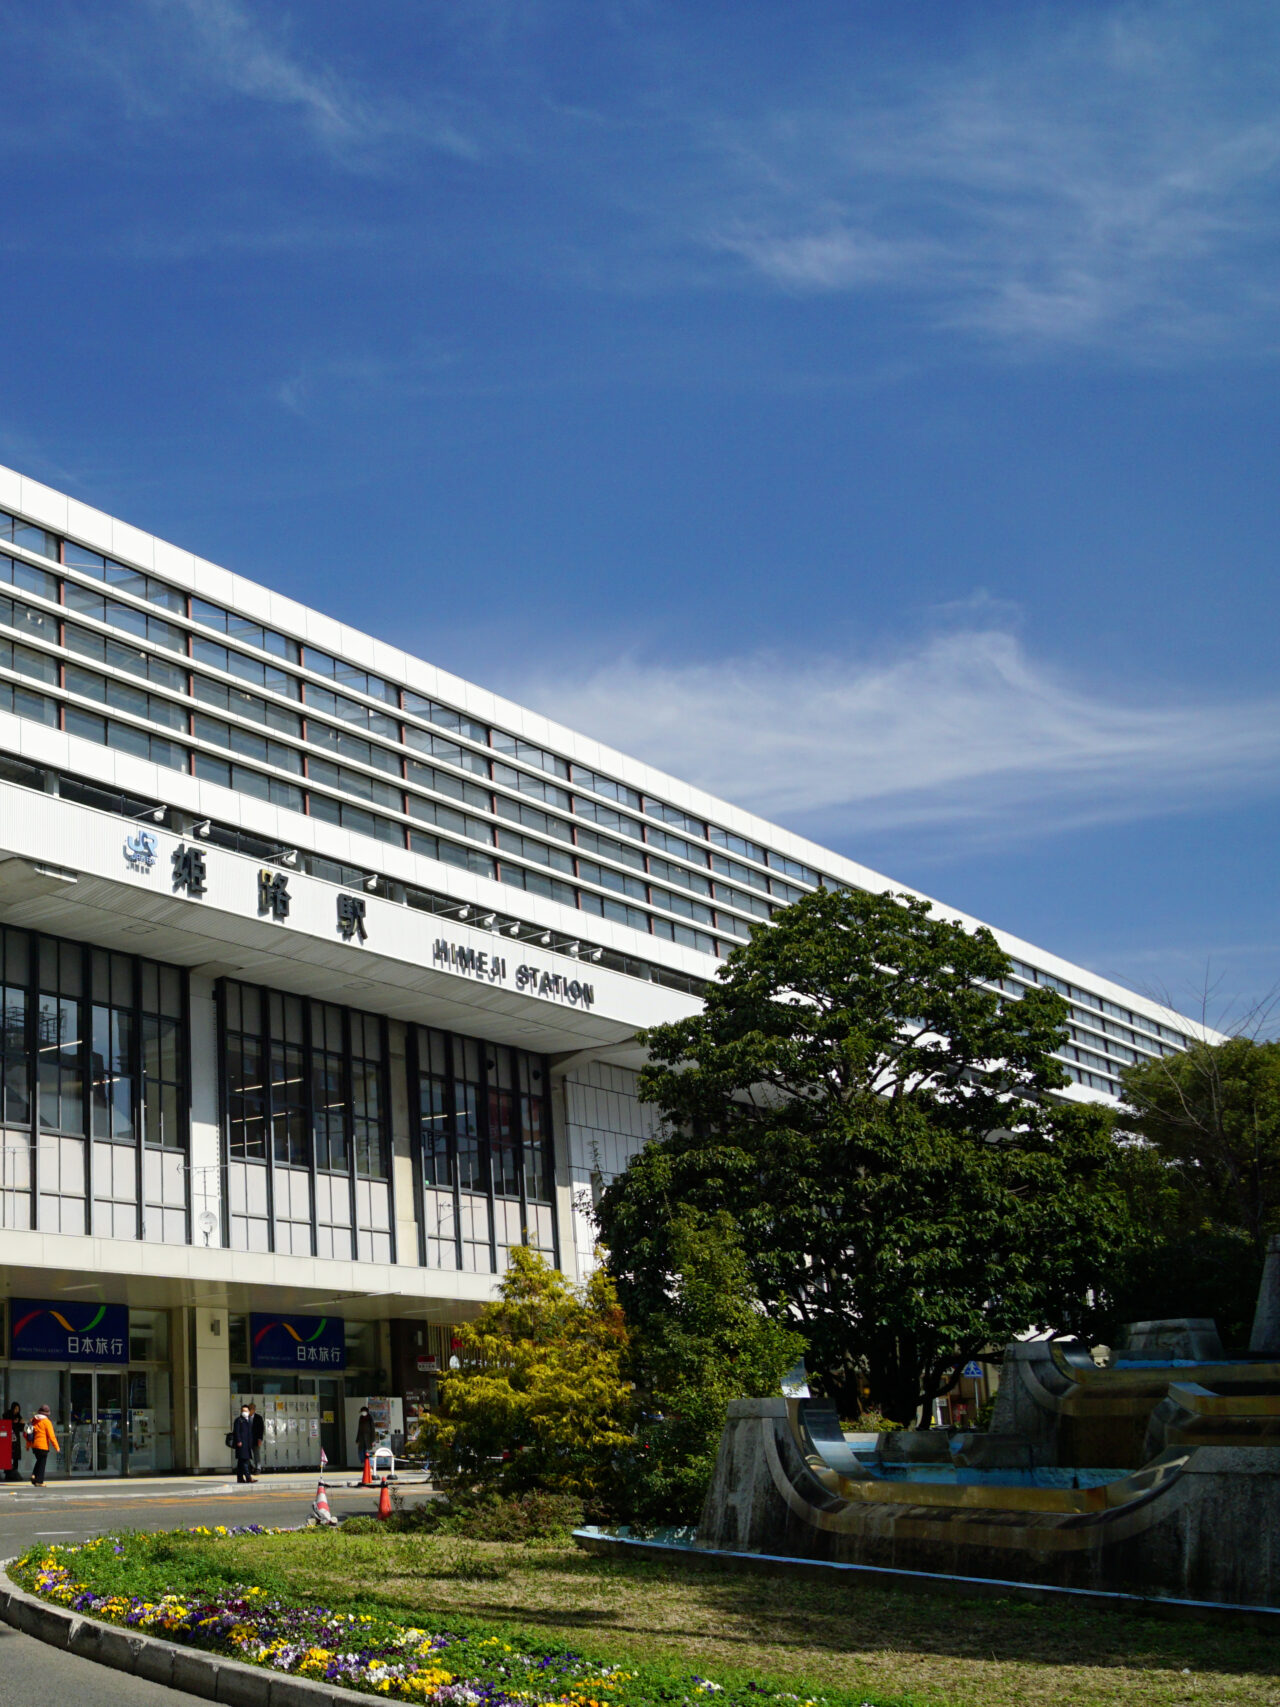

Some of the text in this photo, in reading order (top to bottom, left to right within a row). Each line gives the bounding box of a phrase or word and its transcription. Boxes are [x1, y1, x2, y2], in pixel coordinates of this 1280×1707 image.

[127, 830, 158, 858] JR
[171, 843, 368, 940] 姫路駅
[433, 938, 595, 1005] HIMEJI STATION
[67, 1336, 124, 1355] 日本旅行
[297, 1346, 341, 1363] 日本旅行
